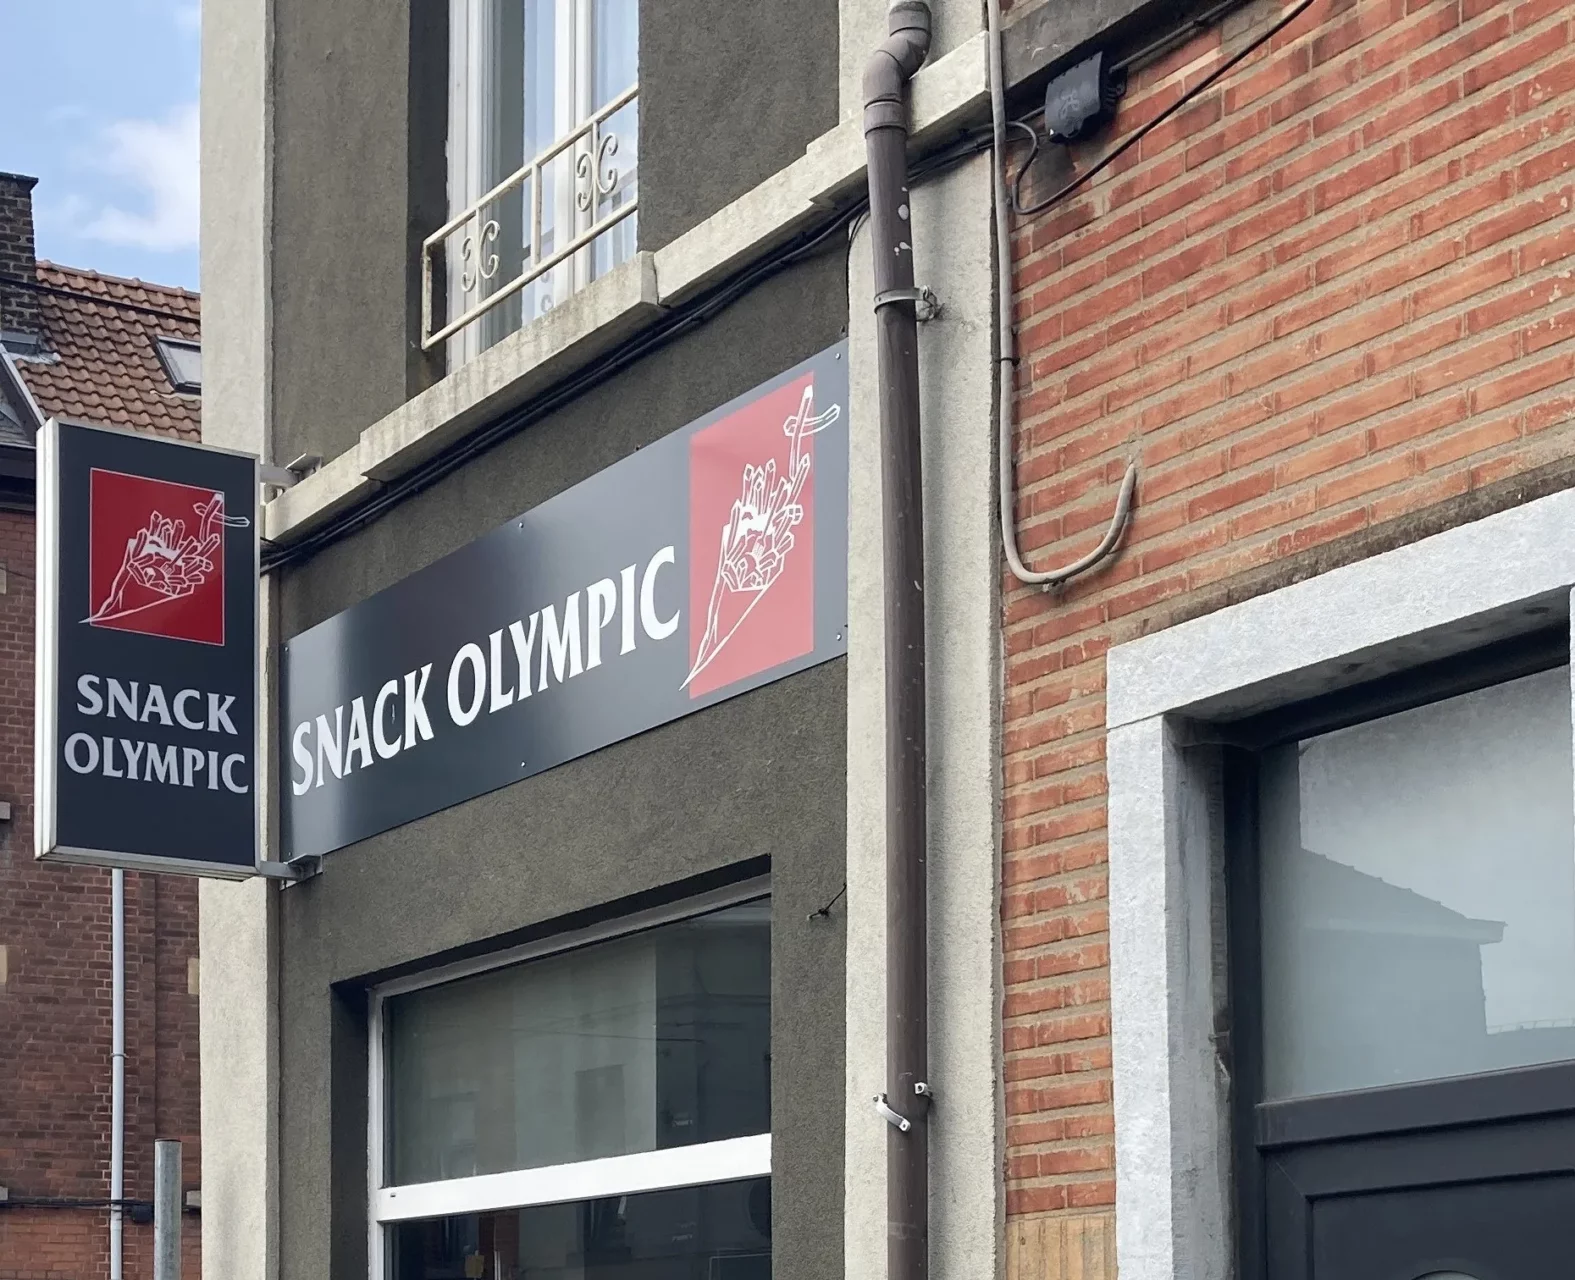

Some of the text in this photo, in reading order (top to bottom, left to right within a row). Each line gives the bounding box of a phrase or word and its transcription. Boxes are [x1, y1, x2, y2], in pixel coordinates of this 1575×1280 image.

[290, 544, 681, 797] SNACK OLYMPIC
[76, 673, 238, 736] SNACK
[64, 732, 249, 794] OLYMPIC
